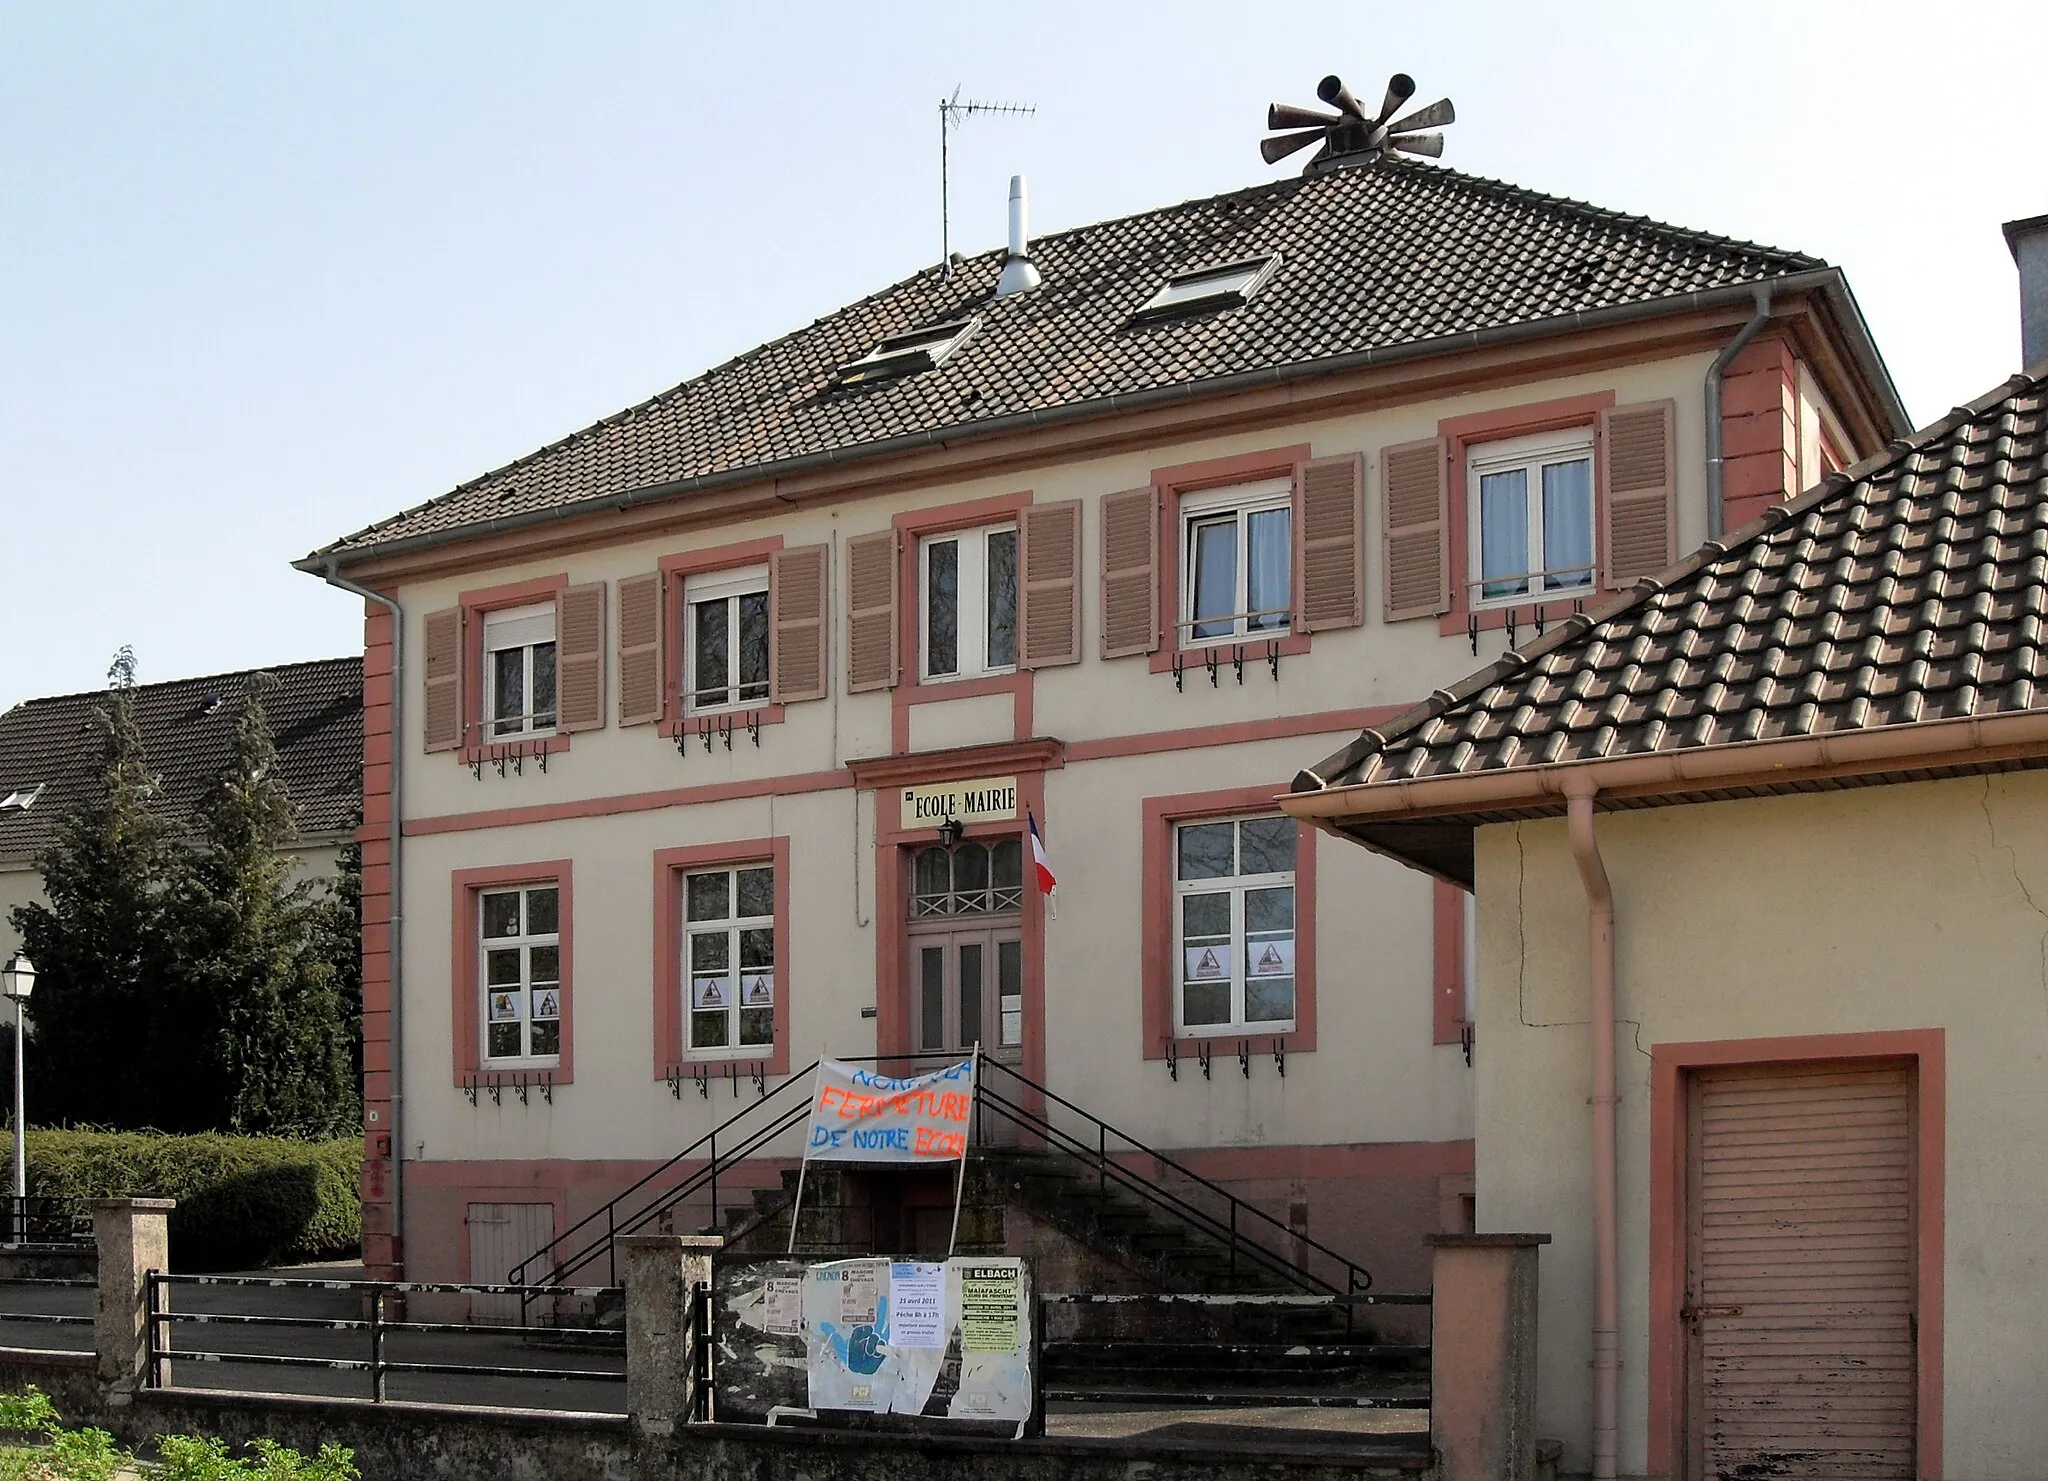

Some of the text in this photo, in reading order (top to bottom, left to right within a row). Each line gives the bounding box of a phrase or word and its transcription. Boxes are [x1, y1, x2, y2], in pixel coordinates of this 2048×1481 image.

[916, 794, 956, 818] ECOLE
[964, 787, 1015, 814] MAIRIE
[811, 1125, 846, 1148] DE
[853, 1128, 909, 1150] NOTRE
[841, 1270, 849, 1281] 8
[974, 1269, 1015, 1278] ELBACH
[766, 1281, 774, 1292] 8
